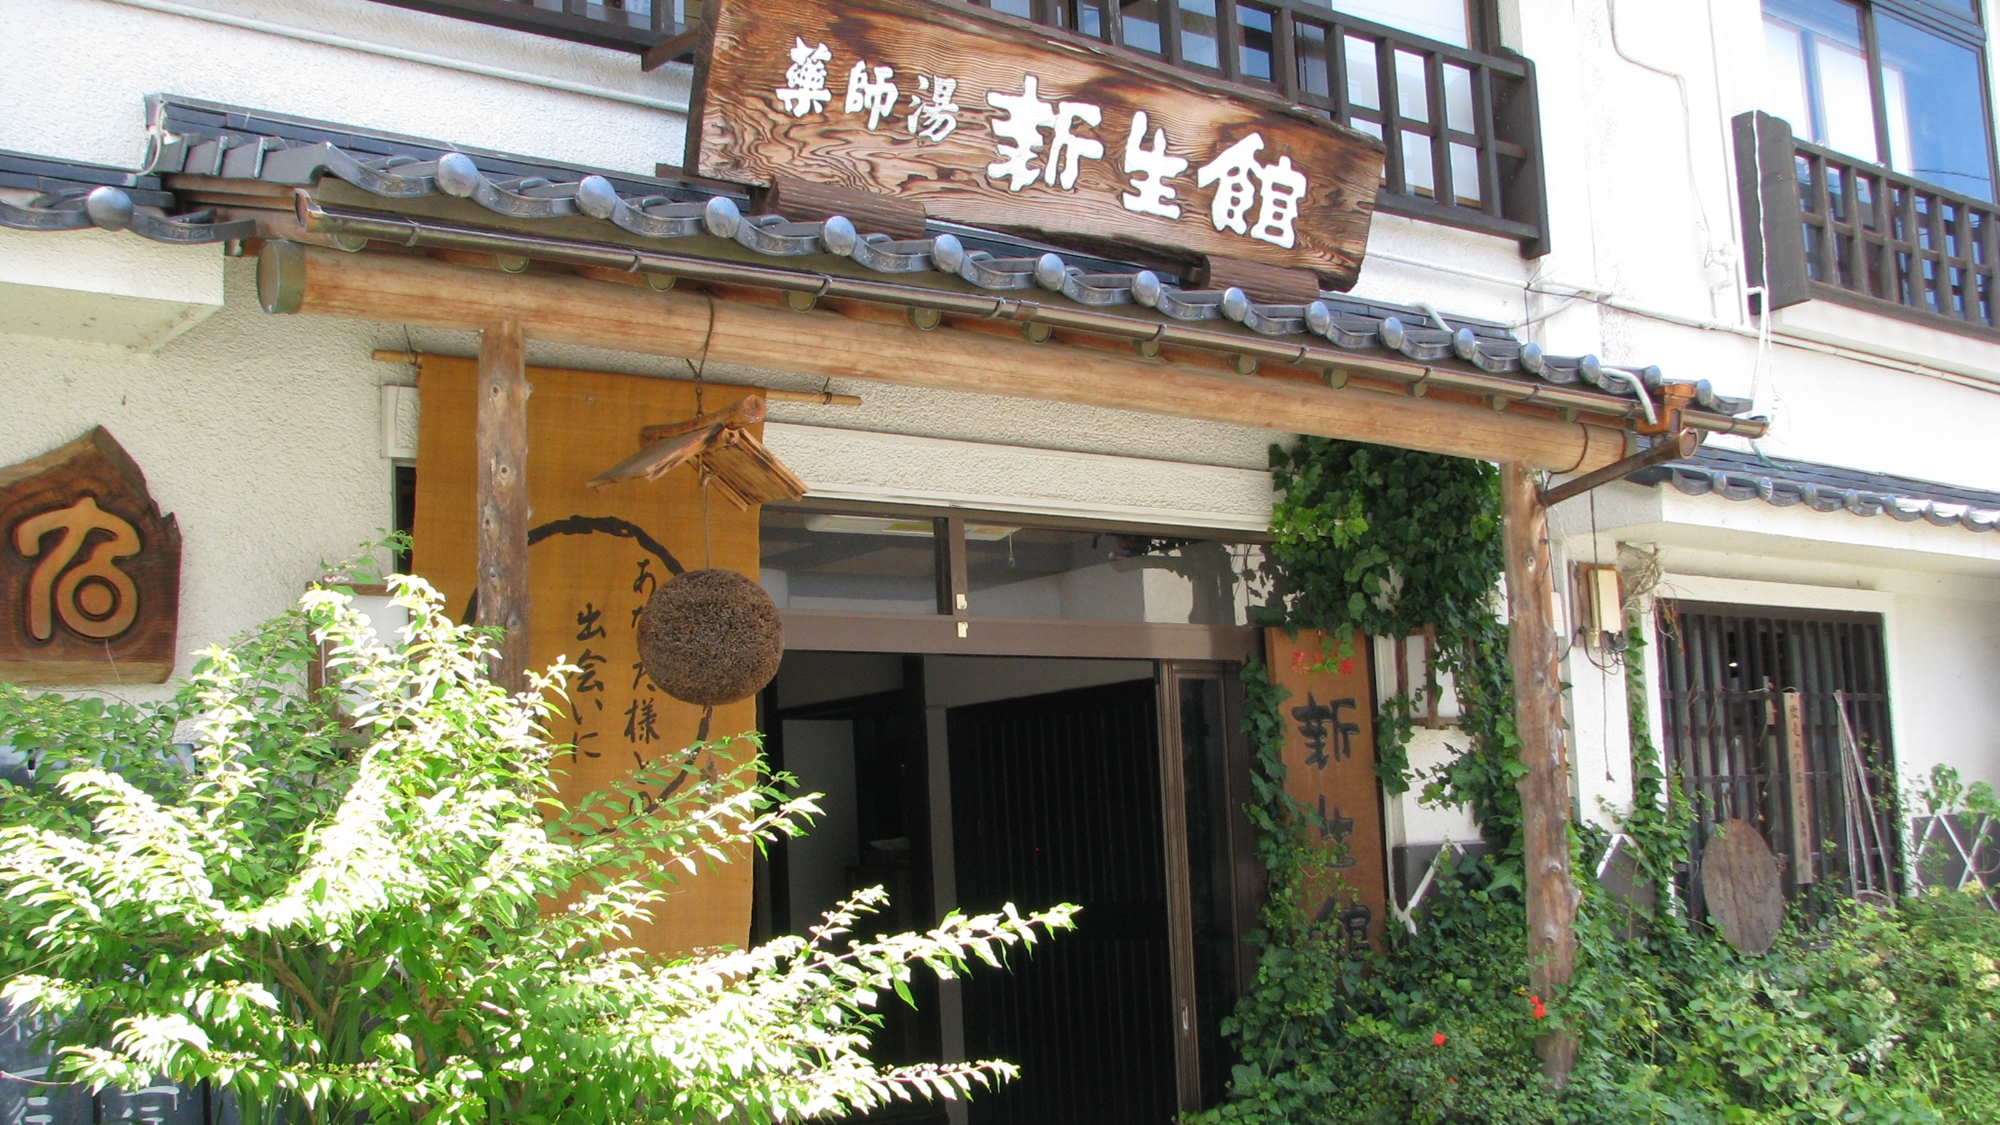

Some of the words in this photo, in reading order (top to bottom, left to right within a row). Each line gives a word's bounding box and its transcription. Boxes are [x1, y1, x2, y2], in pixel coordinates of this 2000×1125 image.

[986, 75, 1307, 249] 新生館
[567, 603, 608, 763] 出会いに
